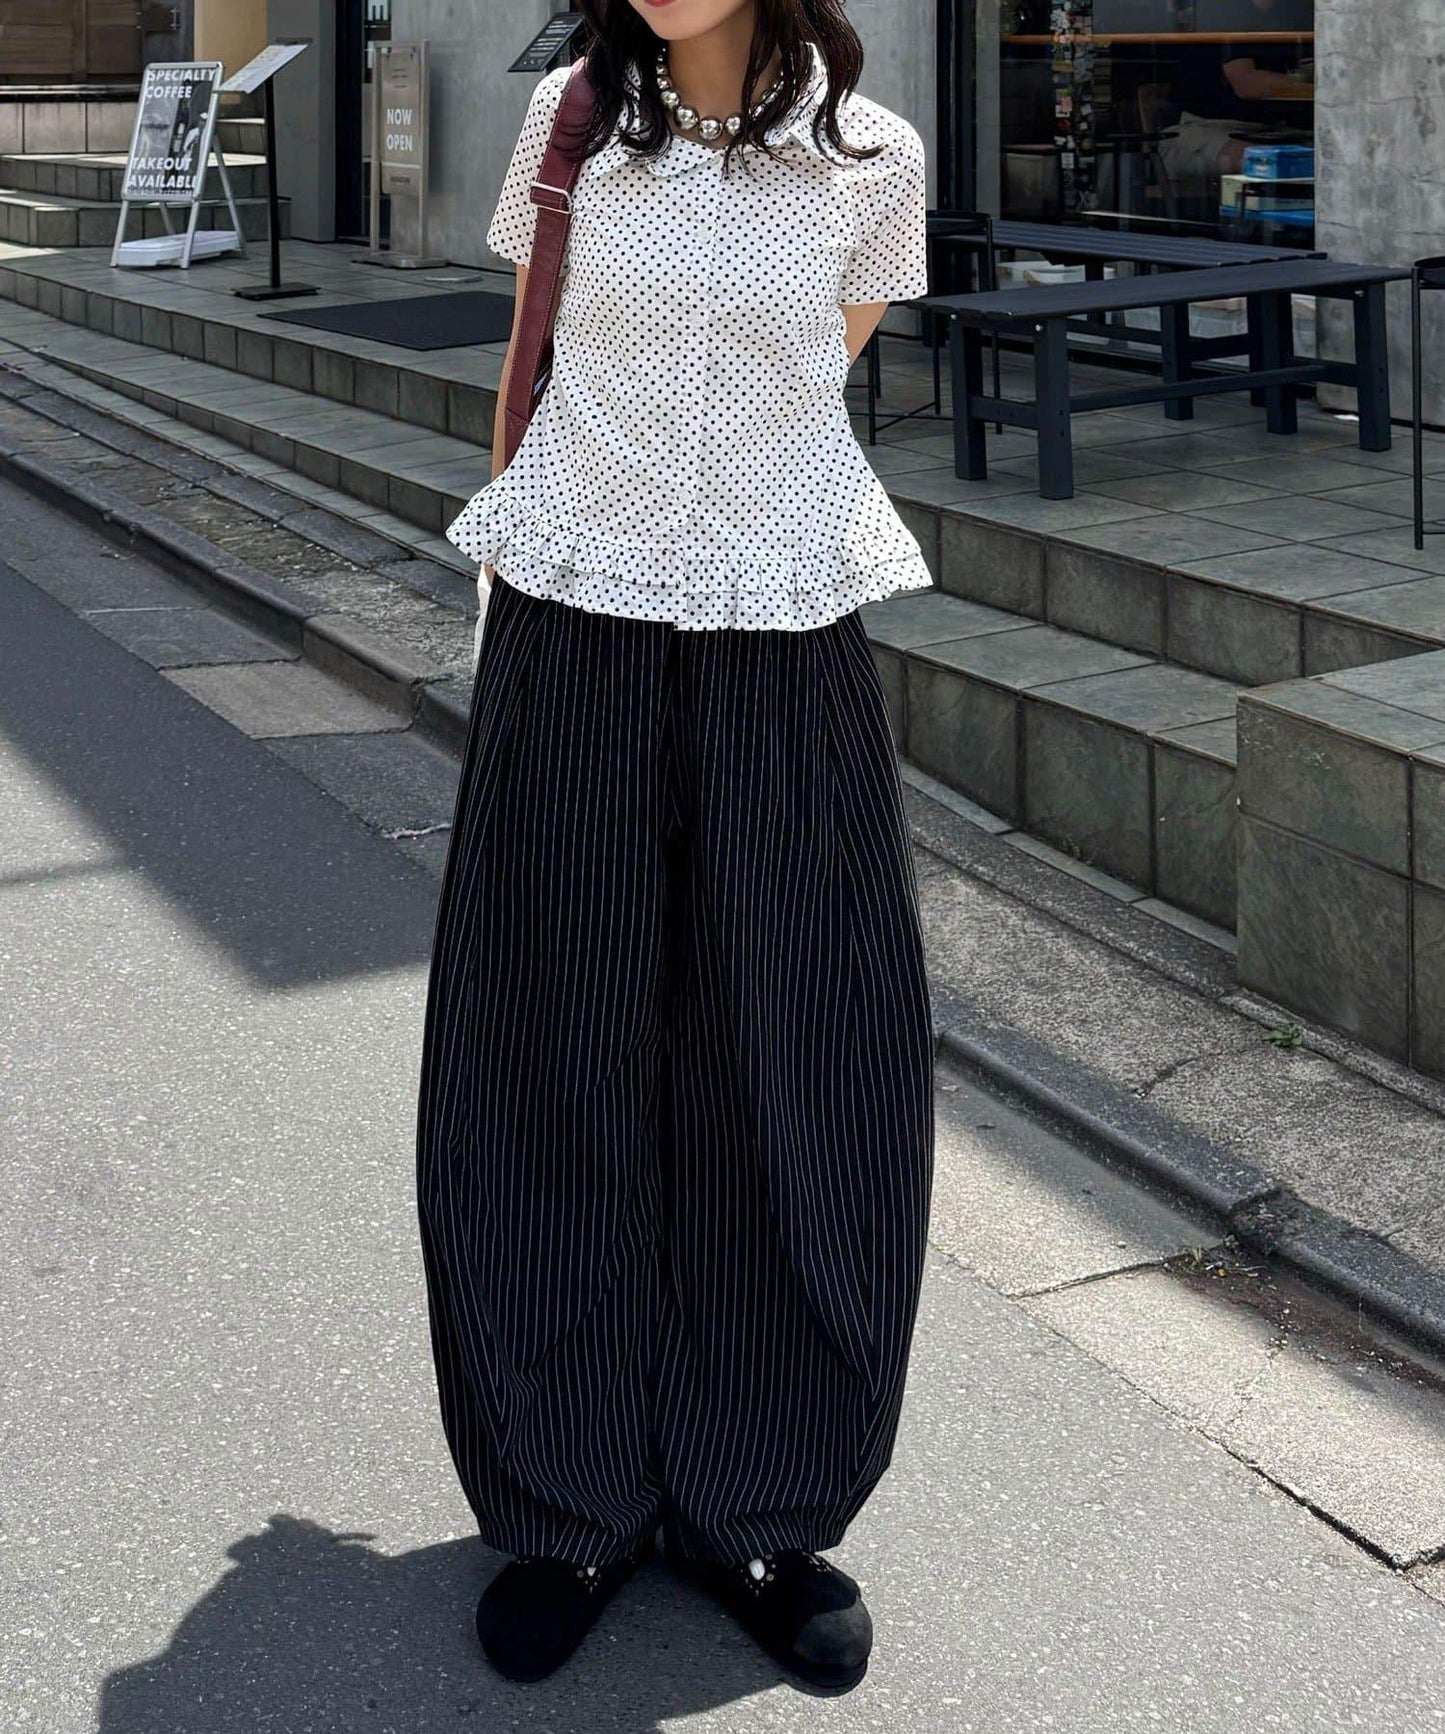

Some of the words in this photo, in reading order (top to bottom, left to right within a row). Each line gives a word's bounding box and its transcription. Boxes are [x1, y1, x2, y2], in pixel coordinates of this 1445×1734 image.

[148, 69, 216, 81] SPECIALTY
[146, 86, 192, 98] COFFEE
[386, 108, 412, 125] NOW
[386, 134, 413, 151] OPEN
[131, 157, 192, 171] TAKEOUT
